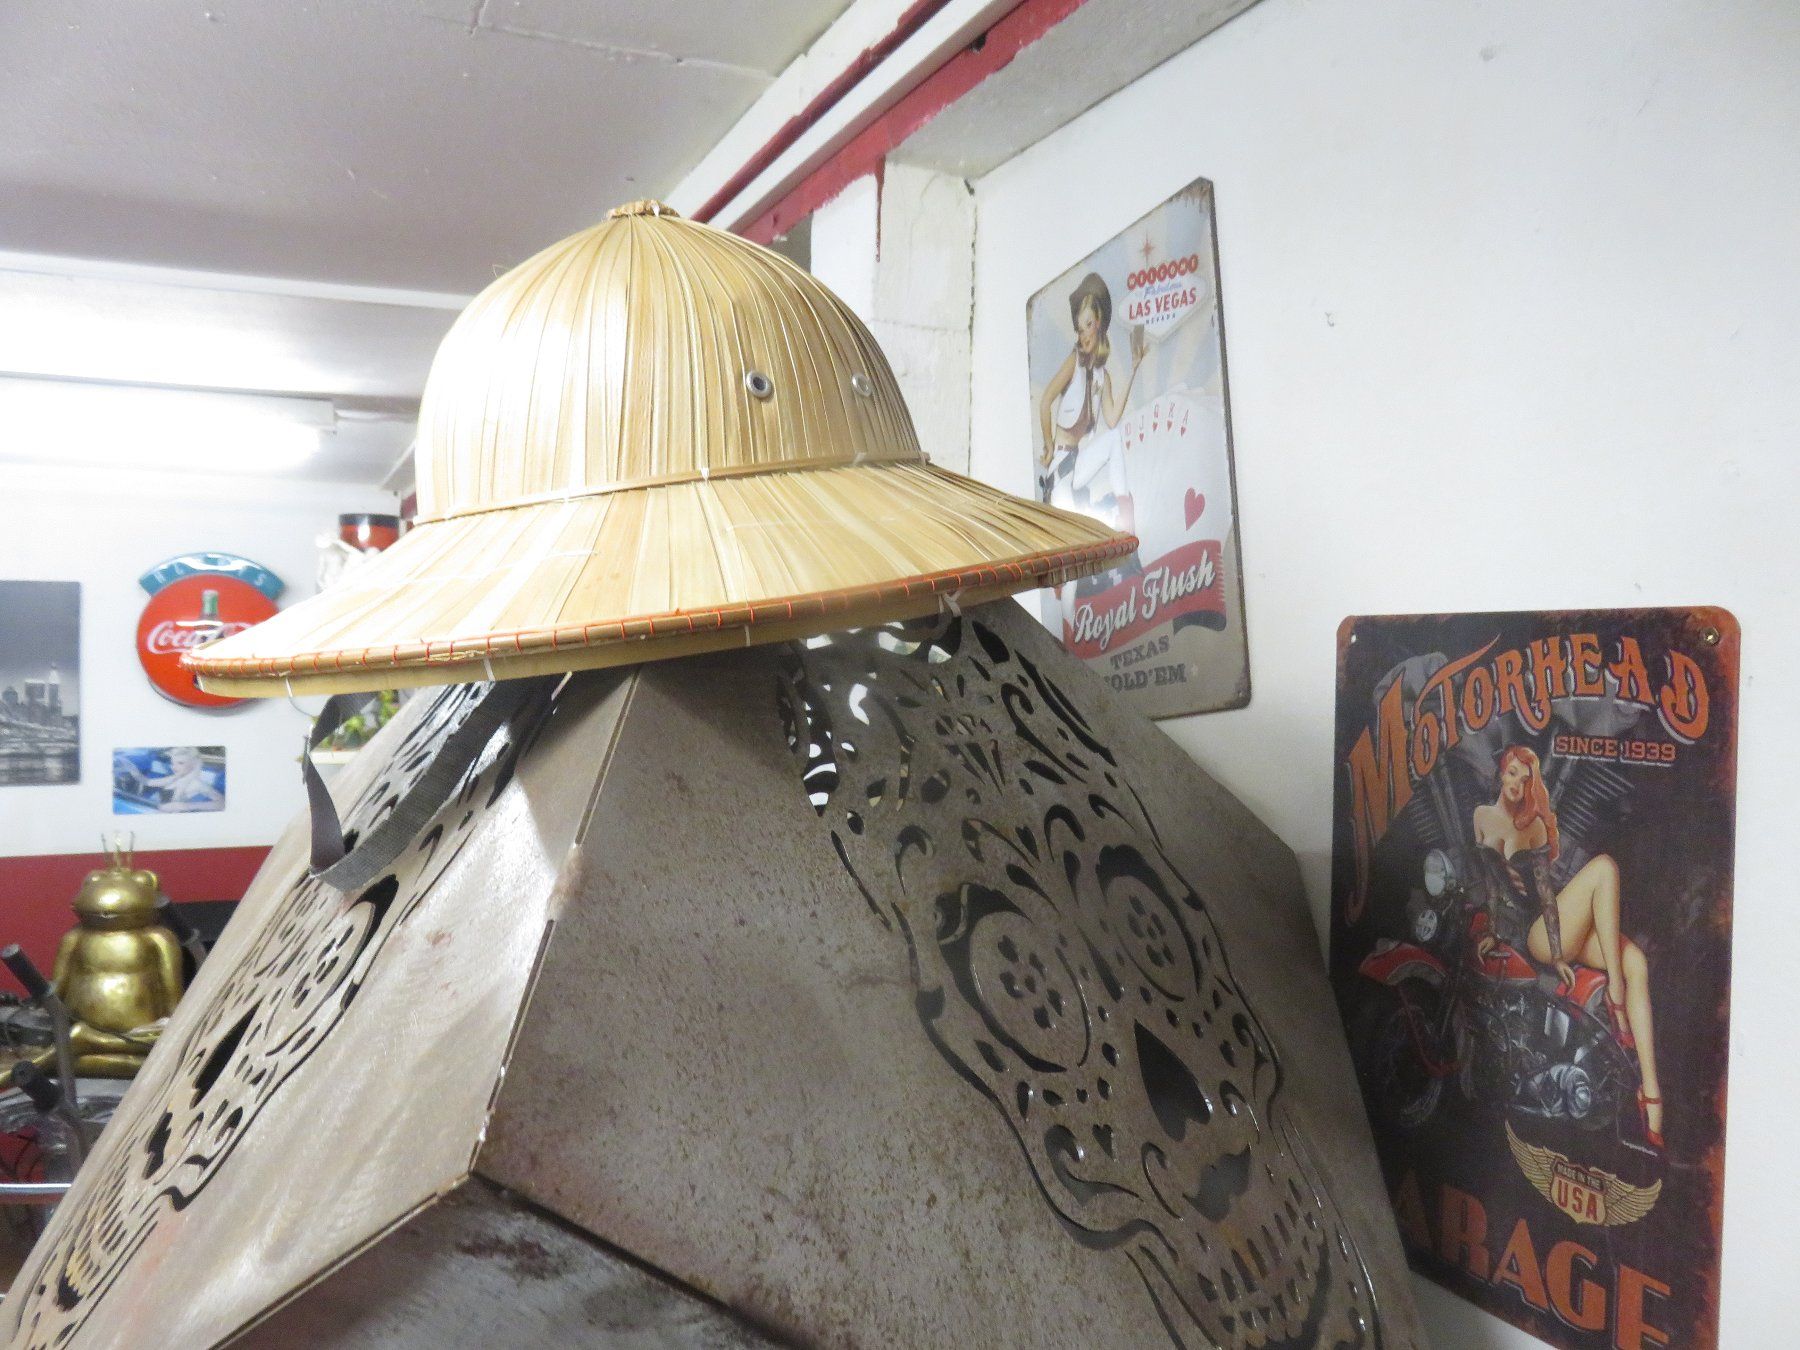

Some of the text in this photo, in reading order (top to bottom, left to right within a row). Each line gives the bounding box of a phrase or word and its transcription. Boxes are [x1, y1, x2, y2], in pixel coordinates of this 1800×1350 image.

[1128, 287, 1196, 320] LAS VEGAS
[1074, 549, 1216, 650] Royal Flush
[1110, 634, 1170, 671] TEXAS
[1103, 663, 1187, 692] OLD'EM
[1556, 736, 1676, 762] SINCE 1939
[1346, 633, 1710, 923] MOTORHEAD
[1557, 1179, 1598, 1222] USA
[1398, 1168, 1671, 1350] ARAGE
